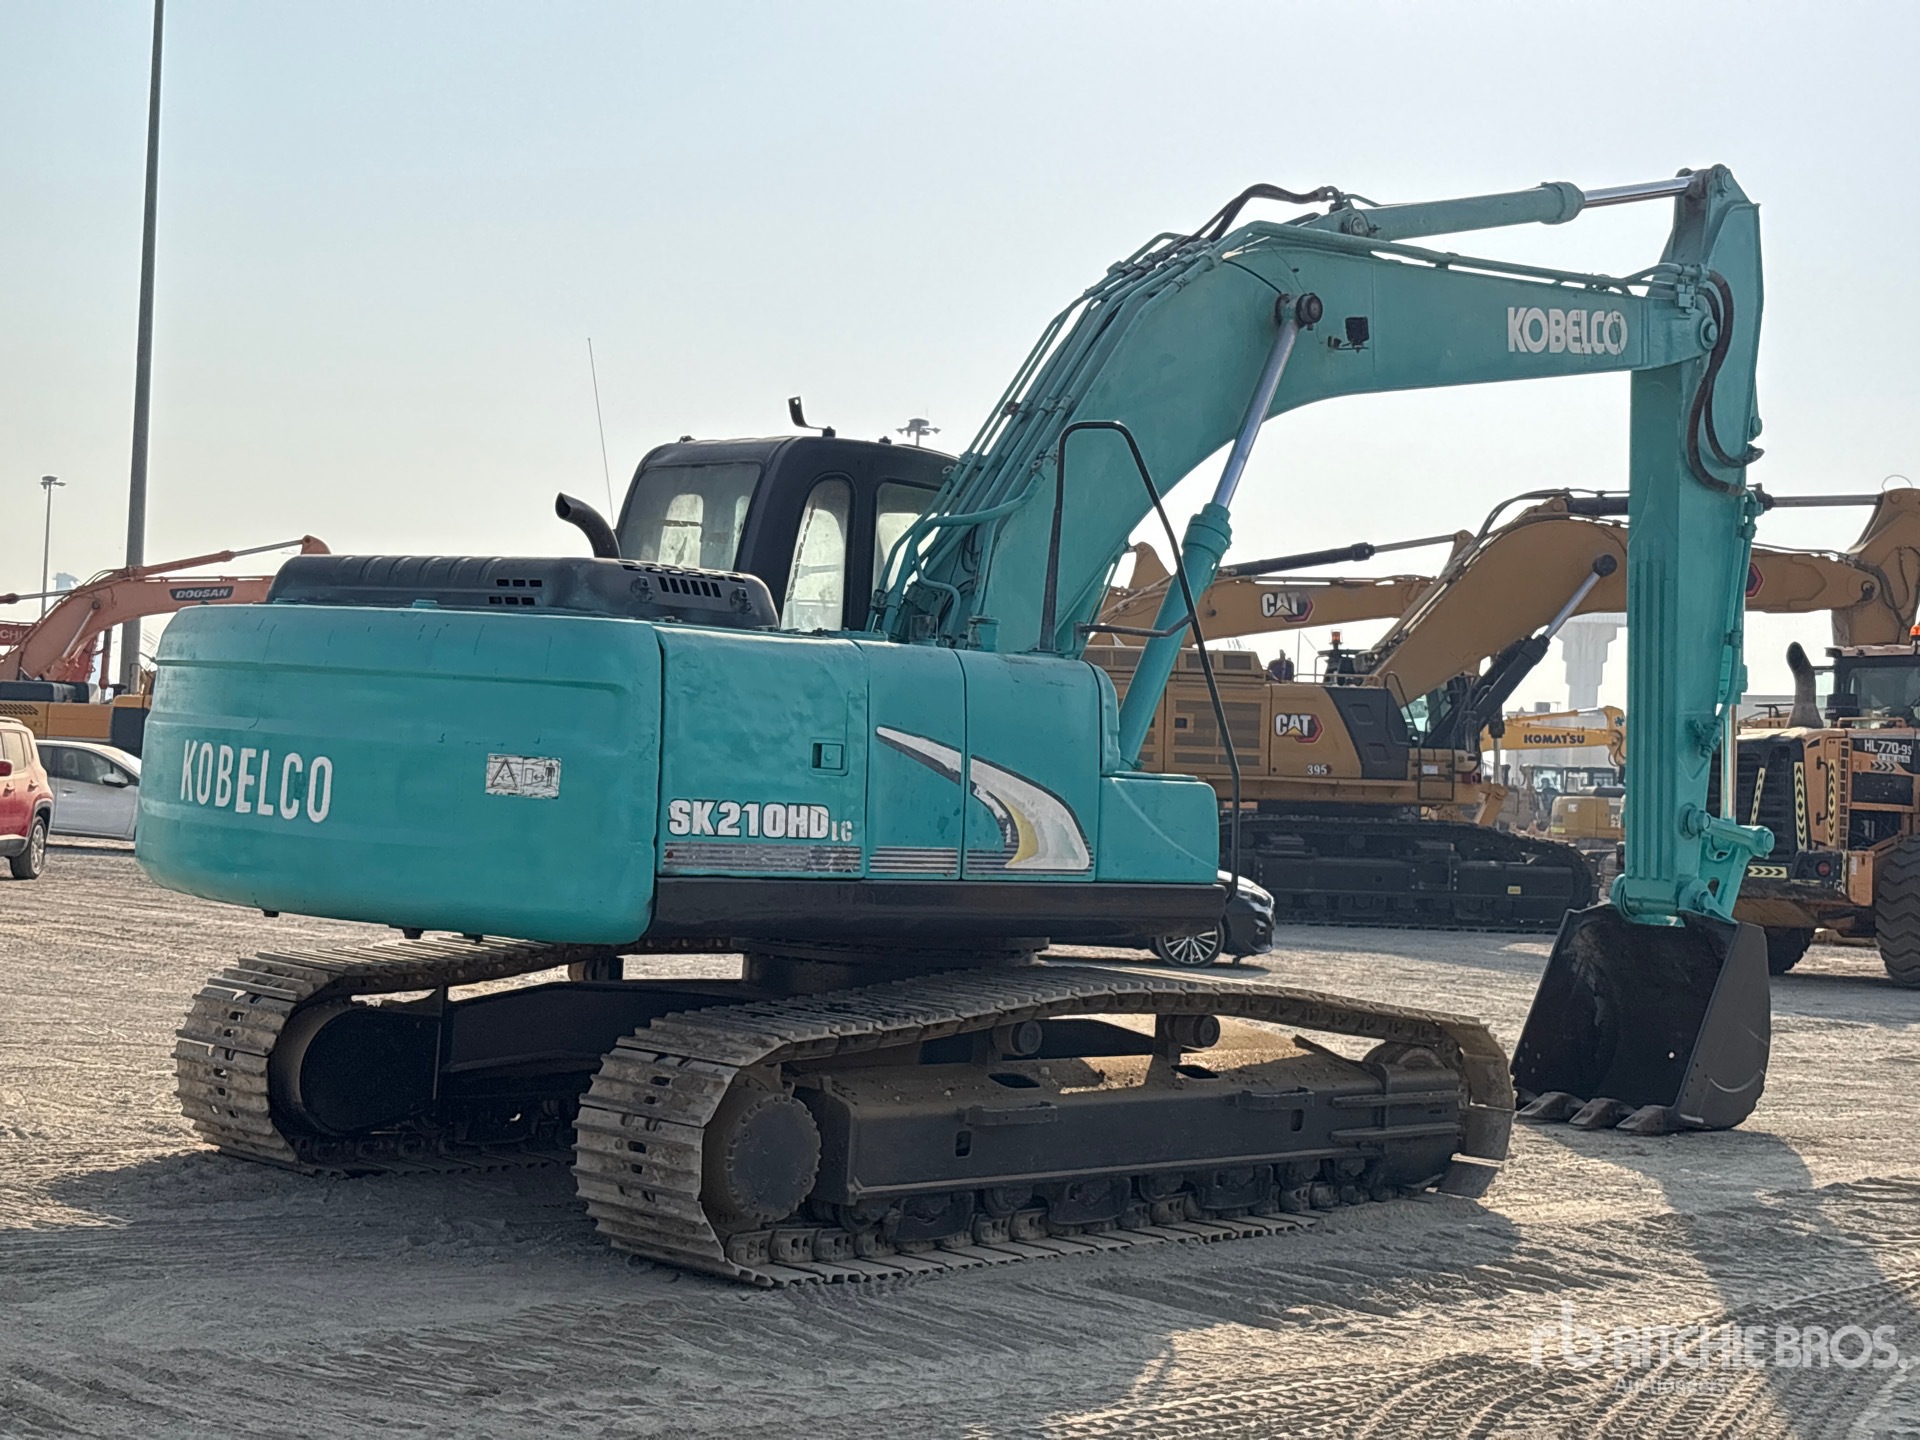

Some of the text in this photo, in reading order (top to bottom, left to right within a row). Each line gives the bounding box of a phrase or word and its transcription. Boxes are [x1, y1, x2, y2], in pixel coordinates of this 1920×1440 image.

[1507, 306, 1628, 356] KOBELCO
[175, 588, 229, 600] DOOSAN
[1261, 591, 1300, 617] CAT
[1275, 713, 1312, 737] CAT
[1523, 733, 1585, 744] KOMATSU
[180, 739, 333, 823] KOBELCO
[1307, 764, 1327, 775] 395
